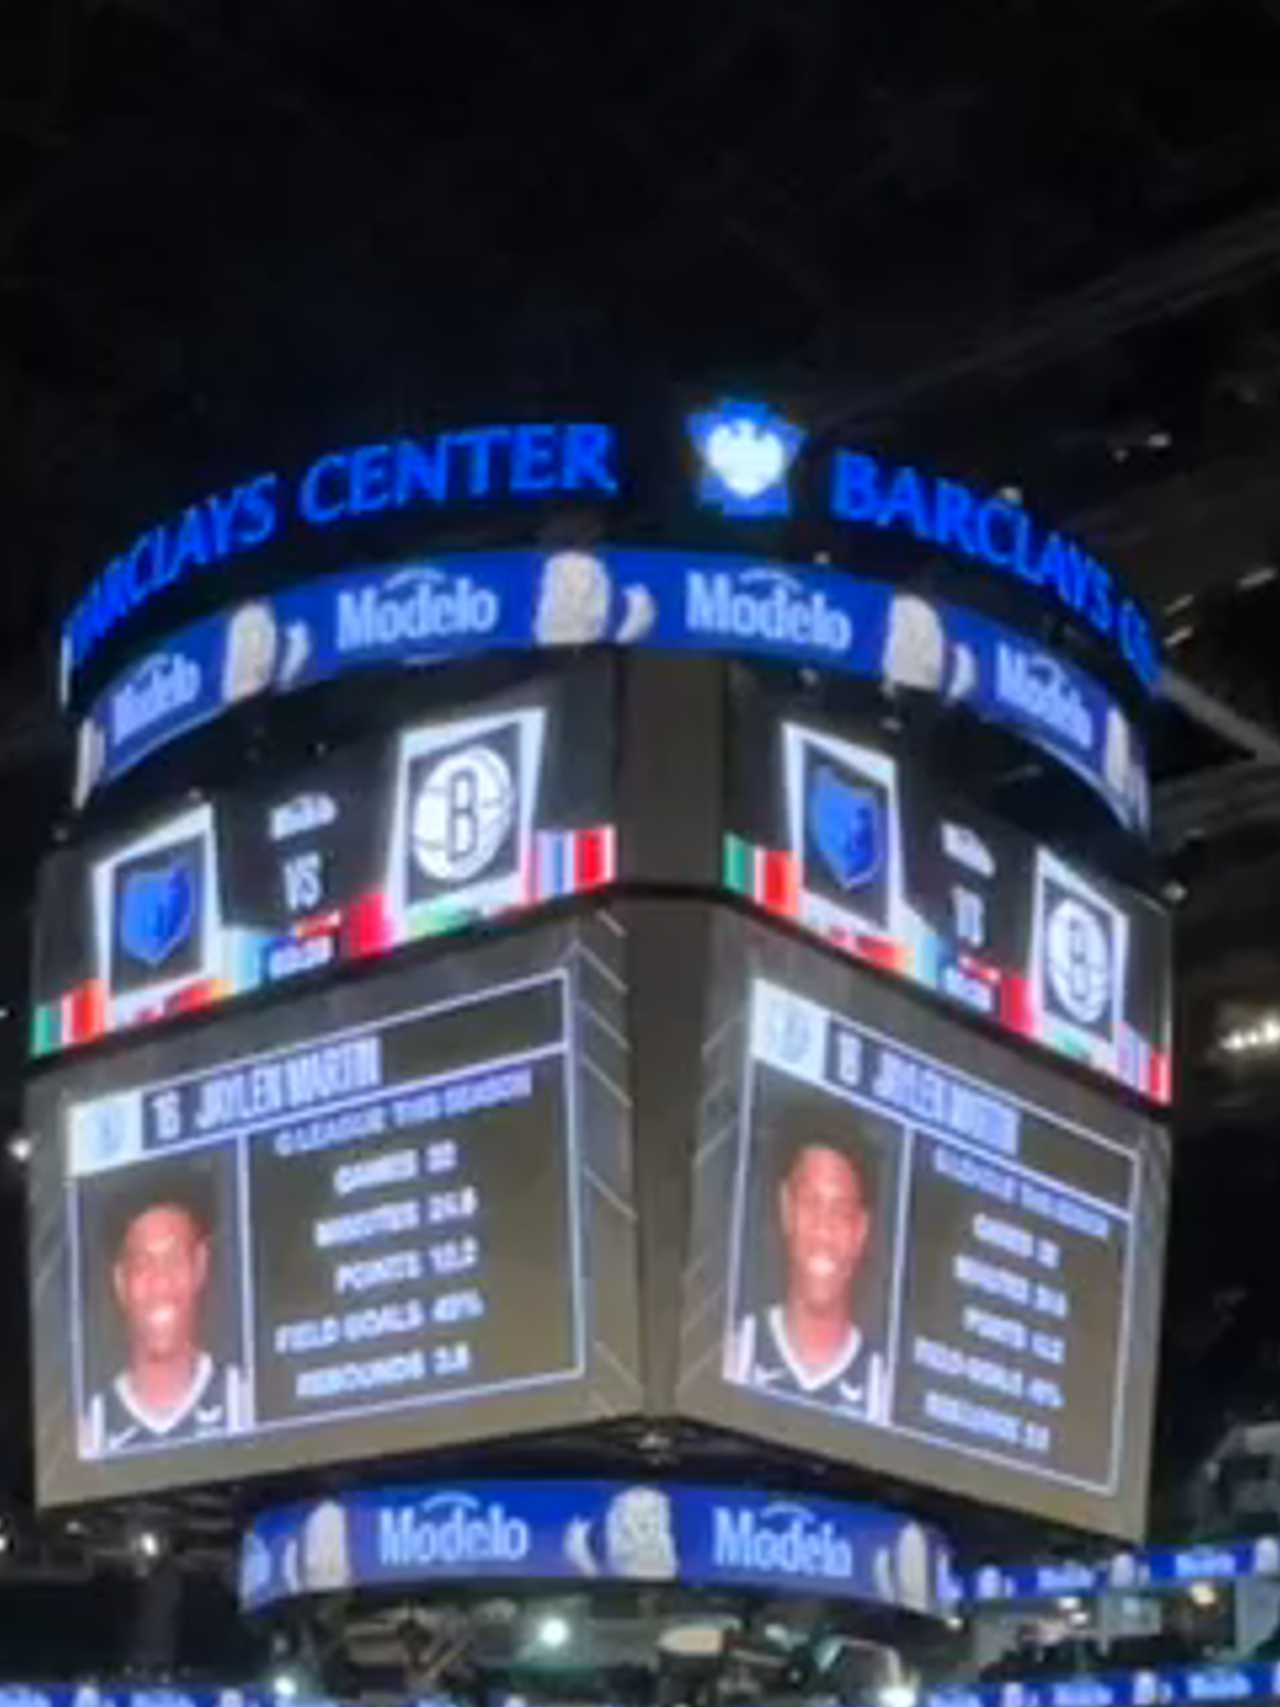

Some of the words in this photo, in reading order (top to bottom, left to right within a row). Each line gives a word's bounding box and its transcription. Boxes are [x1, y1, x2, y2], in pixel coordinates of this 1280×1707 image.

[300, 423, 617, 522] CENTER
[831, 448, 1112, 631] BARCLAYS
[338, 570, 497, 652] Modelo
[686, 570, 852, 653] Modelo
[377, 1492, 531, 1567] Modelo
[713, 1503, 853, 1579] Modelo
